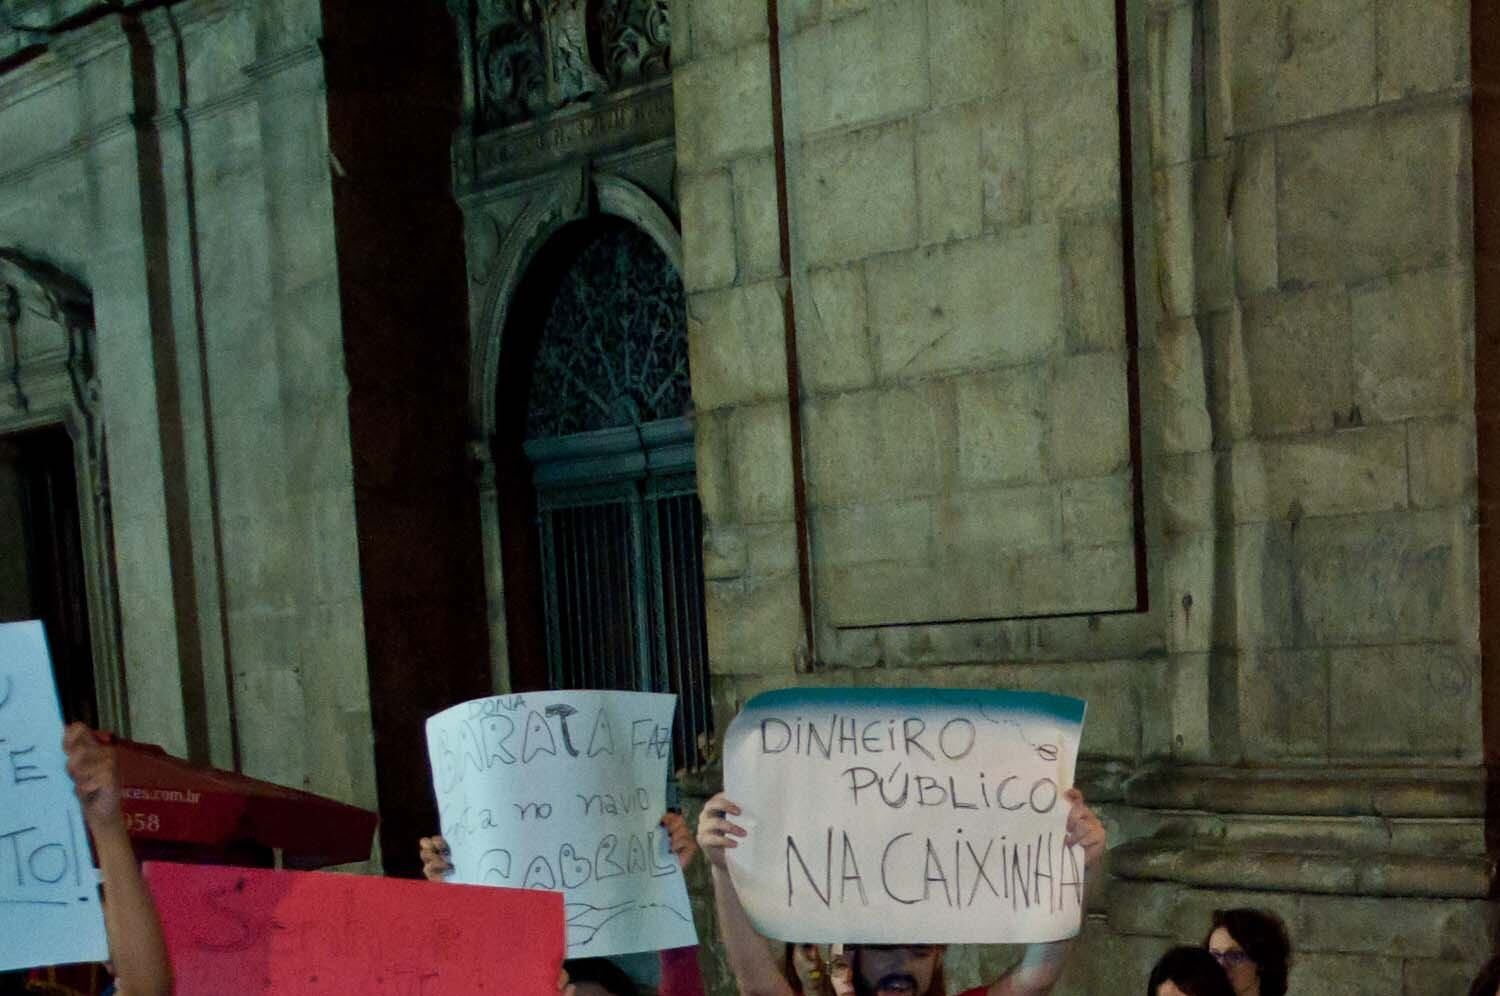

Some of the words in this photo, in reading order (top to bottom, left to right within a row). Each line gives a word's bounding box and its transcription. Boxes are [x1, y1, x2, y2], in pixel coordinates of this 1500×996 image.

[760, 714, 976, 760] DINHEIRO
[513, 802, 552, 821] no
[842, 762, 1058, 814] PÚBLICO
[785, 826, 866, 910] NA
[881, 828, 1086, 914] CAIXINHA
